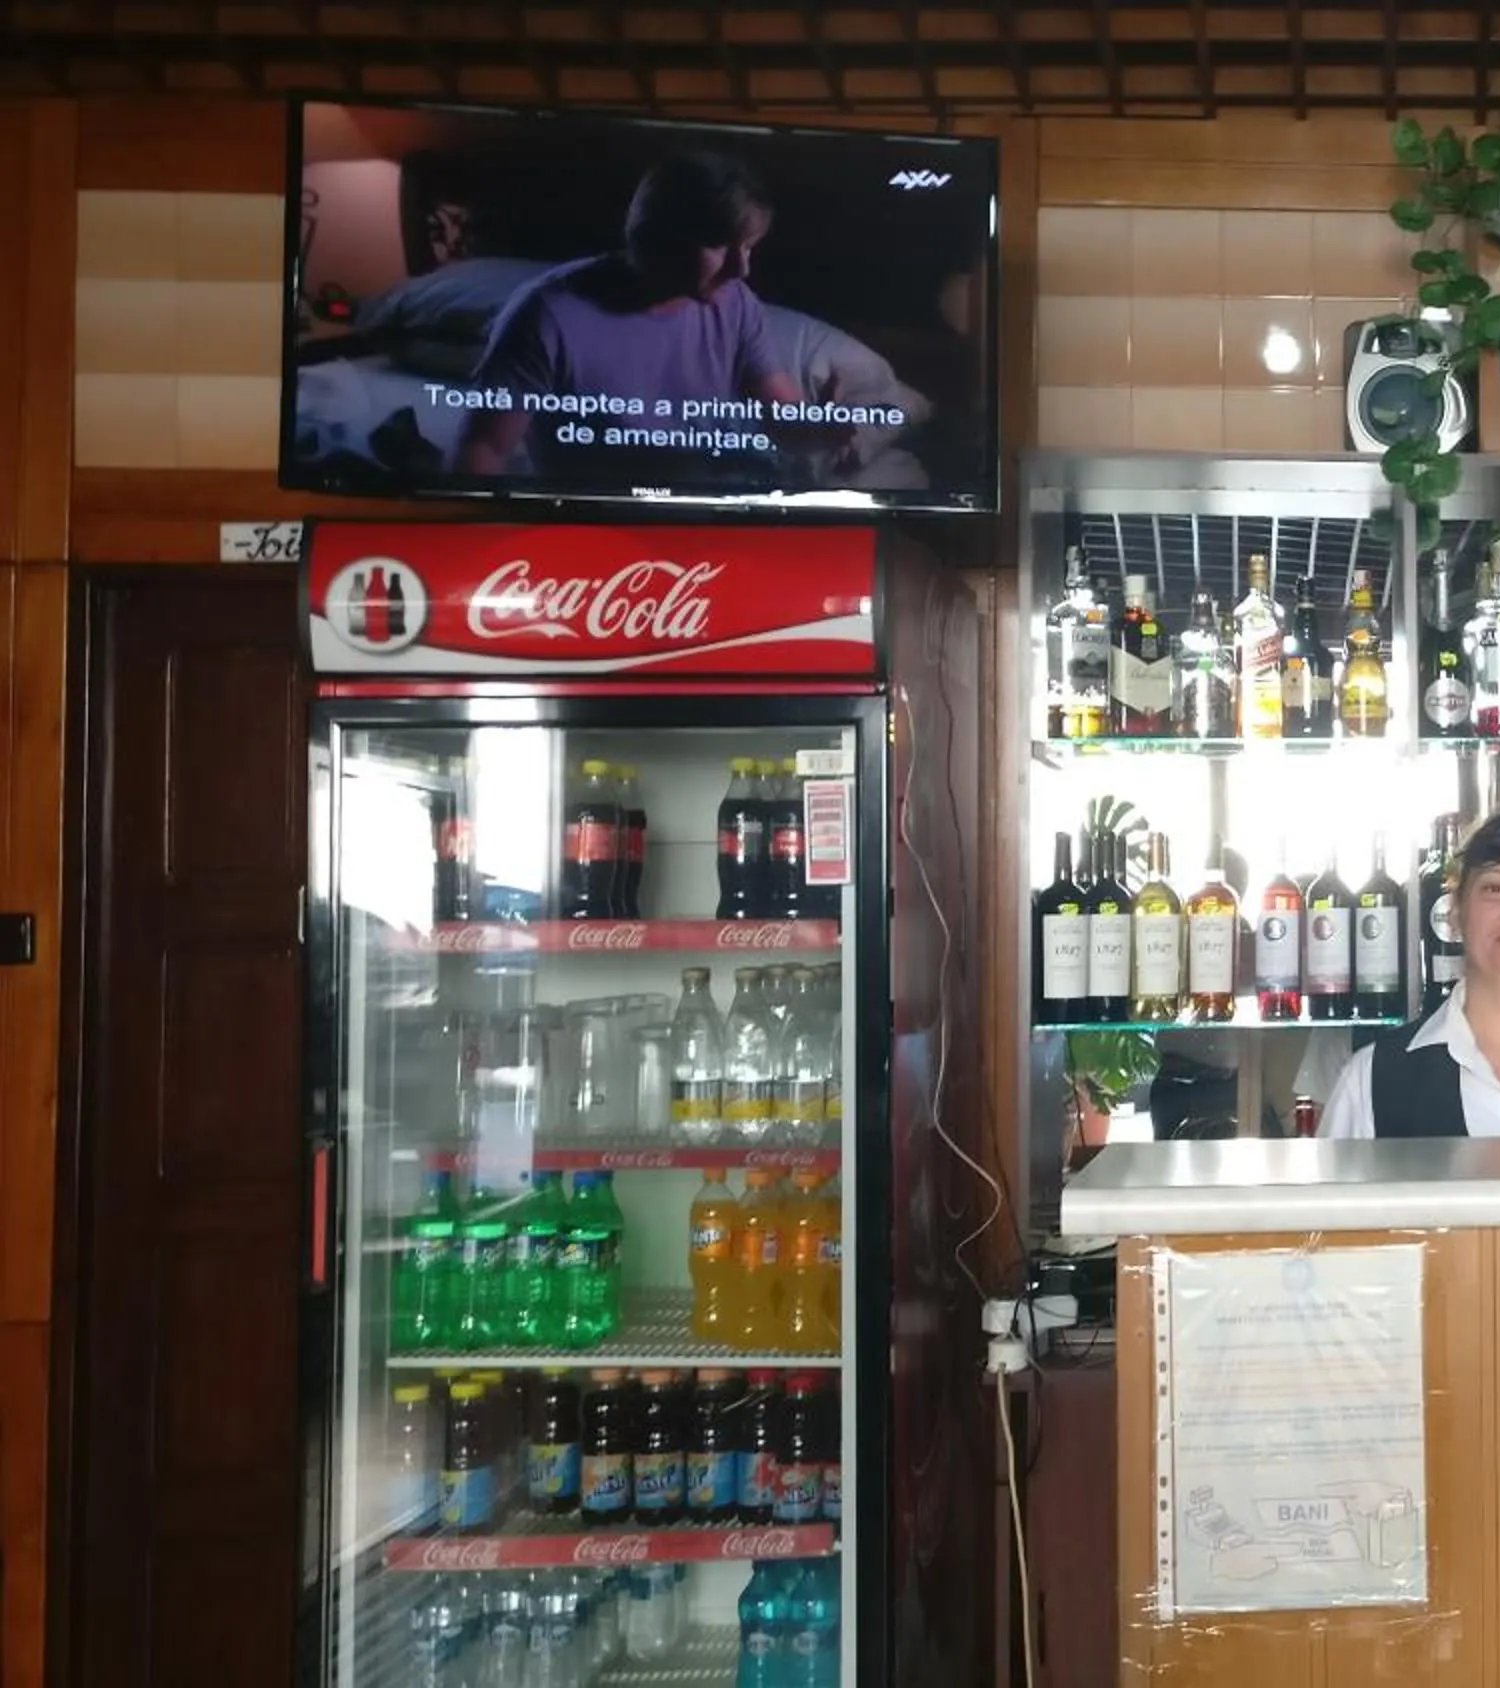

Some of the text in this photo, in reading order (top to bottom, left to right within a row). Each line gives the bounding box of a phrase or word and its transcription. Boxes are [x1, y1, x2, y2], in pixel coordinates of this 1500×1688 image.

[888, 169, 952, 190] AXN
[424, 383, 904, 425] Toată noaptea a primit telefoane
[556, 421, 595, 444] de
[1277, 1503, 1329, 1522] BANI
